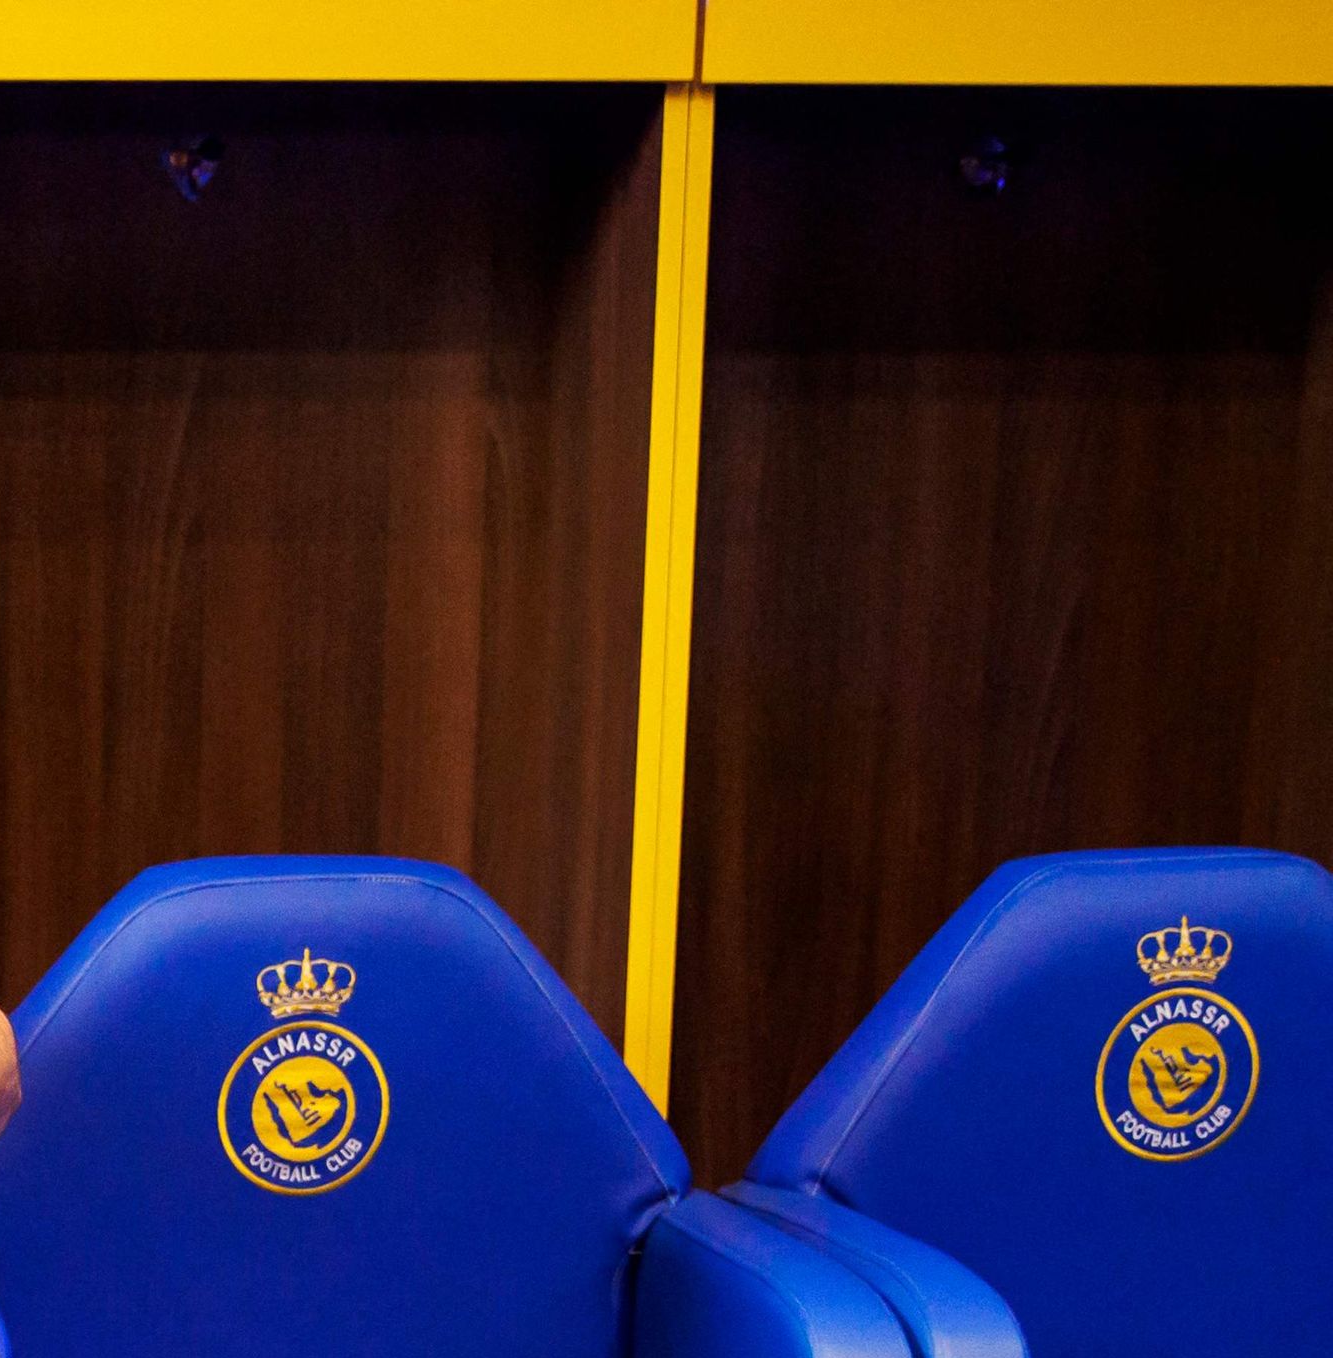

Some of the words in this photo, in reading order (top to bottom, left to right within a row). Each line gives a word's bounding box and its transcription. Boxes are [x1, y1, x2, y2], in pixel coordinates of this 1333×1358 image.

[1130, 998, 1231, 1042] ALNASSR
[252, 1031, 356, 1075] ALNASSR
[1116, 1110, 1190, 1148] FOOTBALL
[1195, 1104, 1232, 1139] CLUB
[242, 1143, 320, 1182] FOOTBALL
[326, 1137, 363, 1172] CLUB
